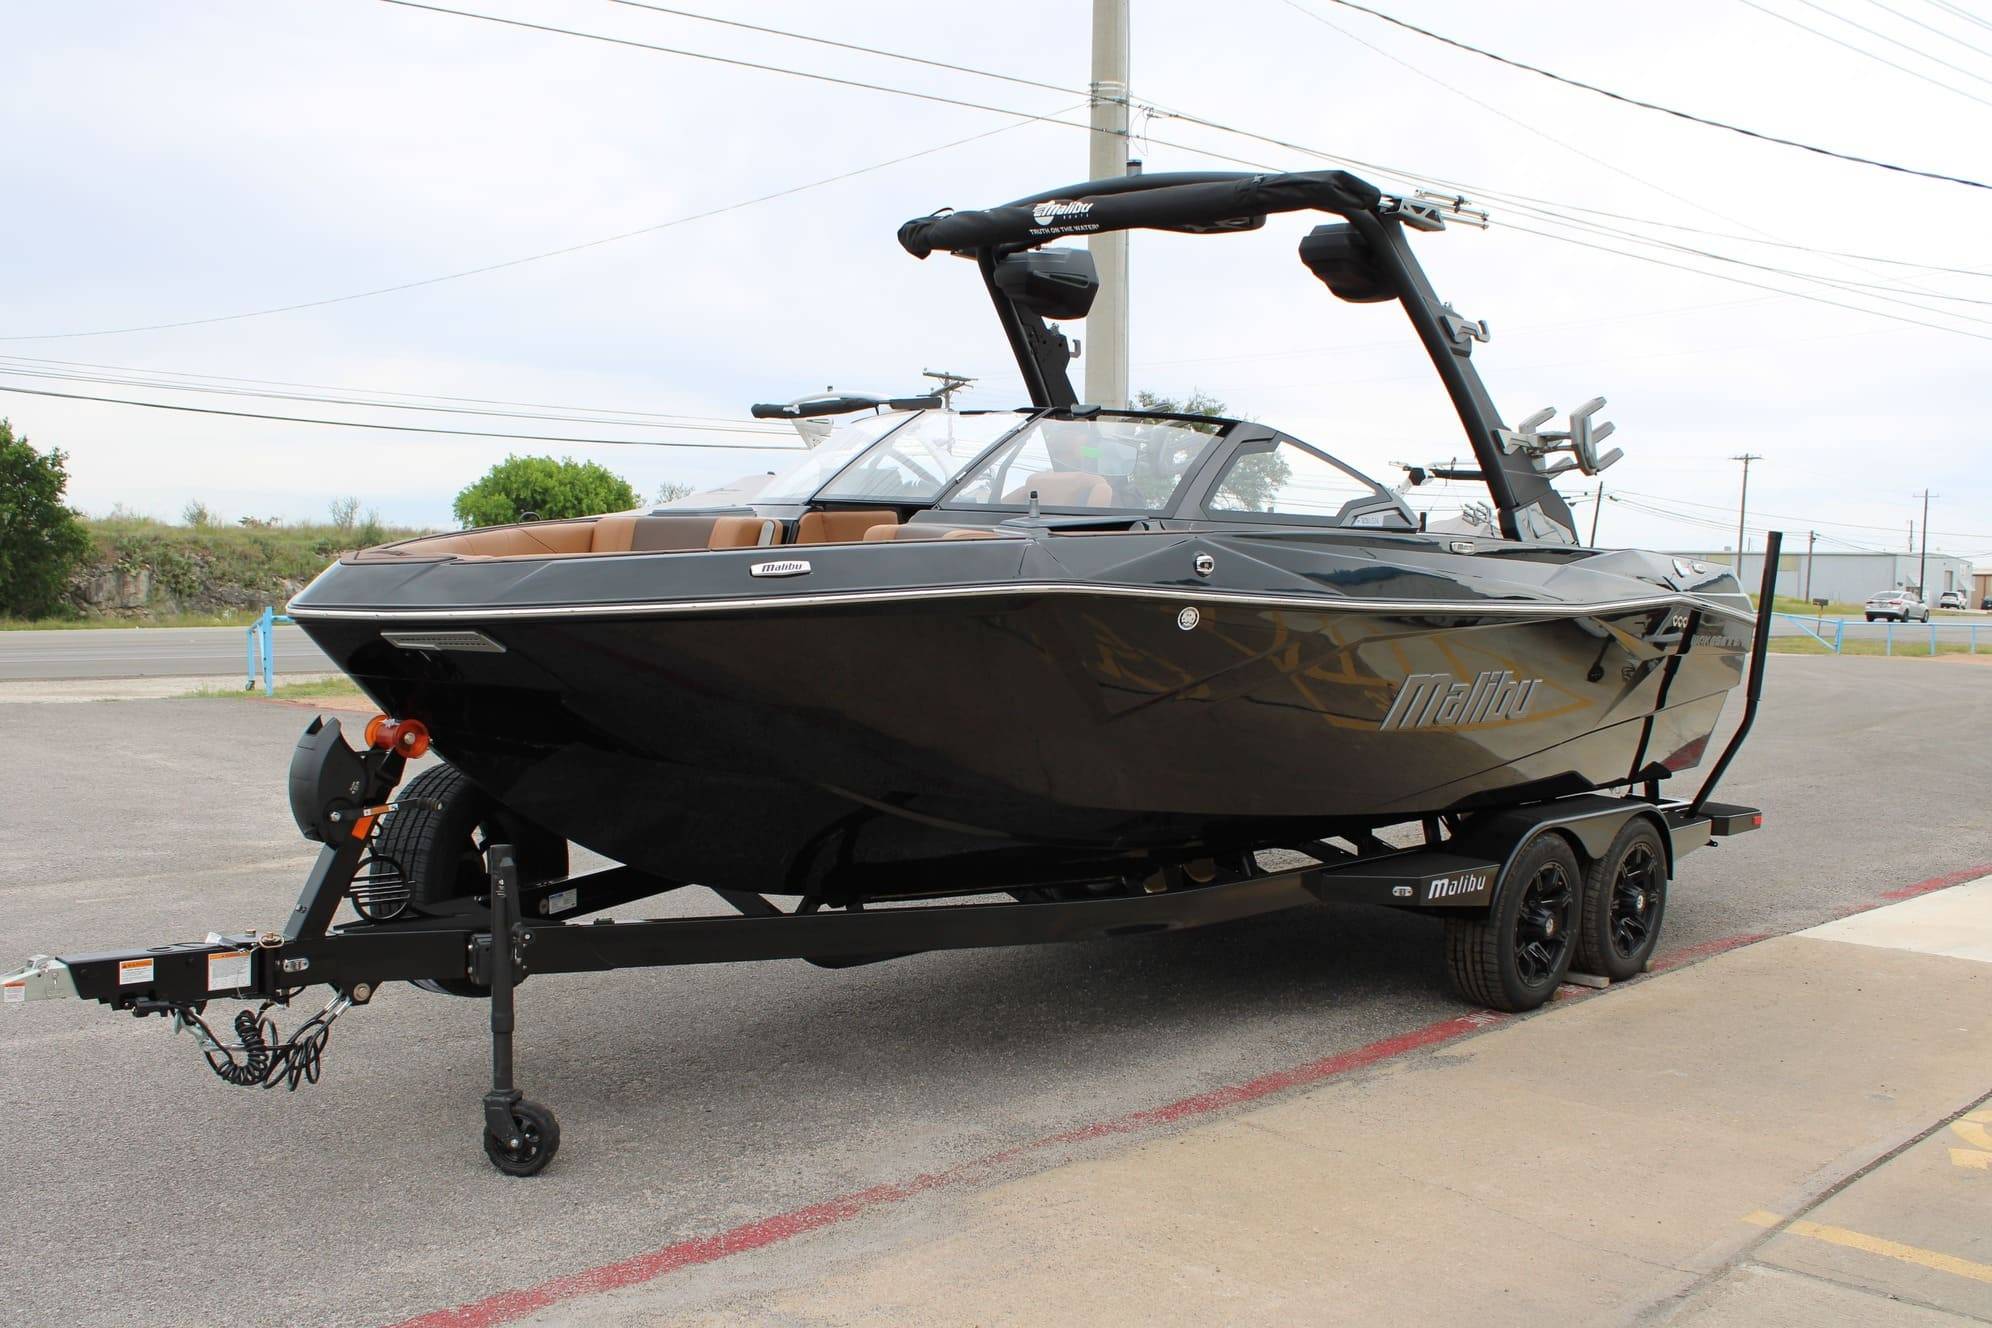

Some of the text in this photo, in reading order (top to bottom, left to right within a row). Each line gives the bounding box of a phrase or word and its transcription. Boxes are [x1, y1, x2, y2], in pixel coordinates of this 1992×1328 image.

[1042, 201, 1094, 216] Malibu
[1051, 226, 1060, 234] ON
[1060, 225, 1074, 233] THE
[762, 563, 802, 573] Malibu
[1379, 670, 1544, 732] Malibu
[1428, 874, 1486, 899] Malibu
